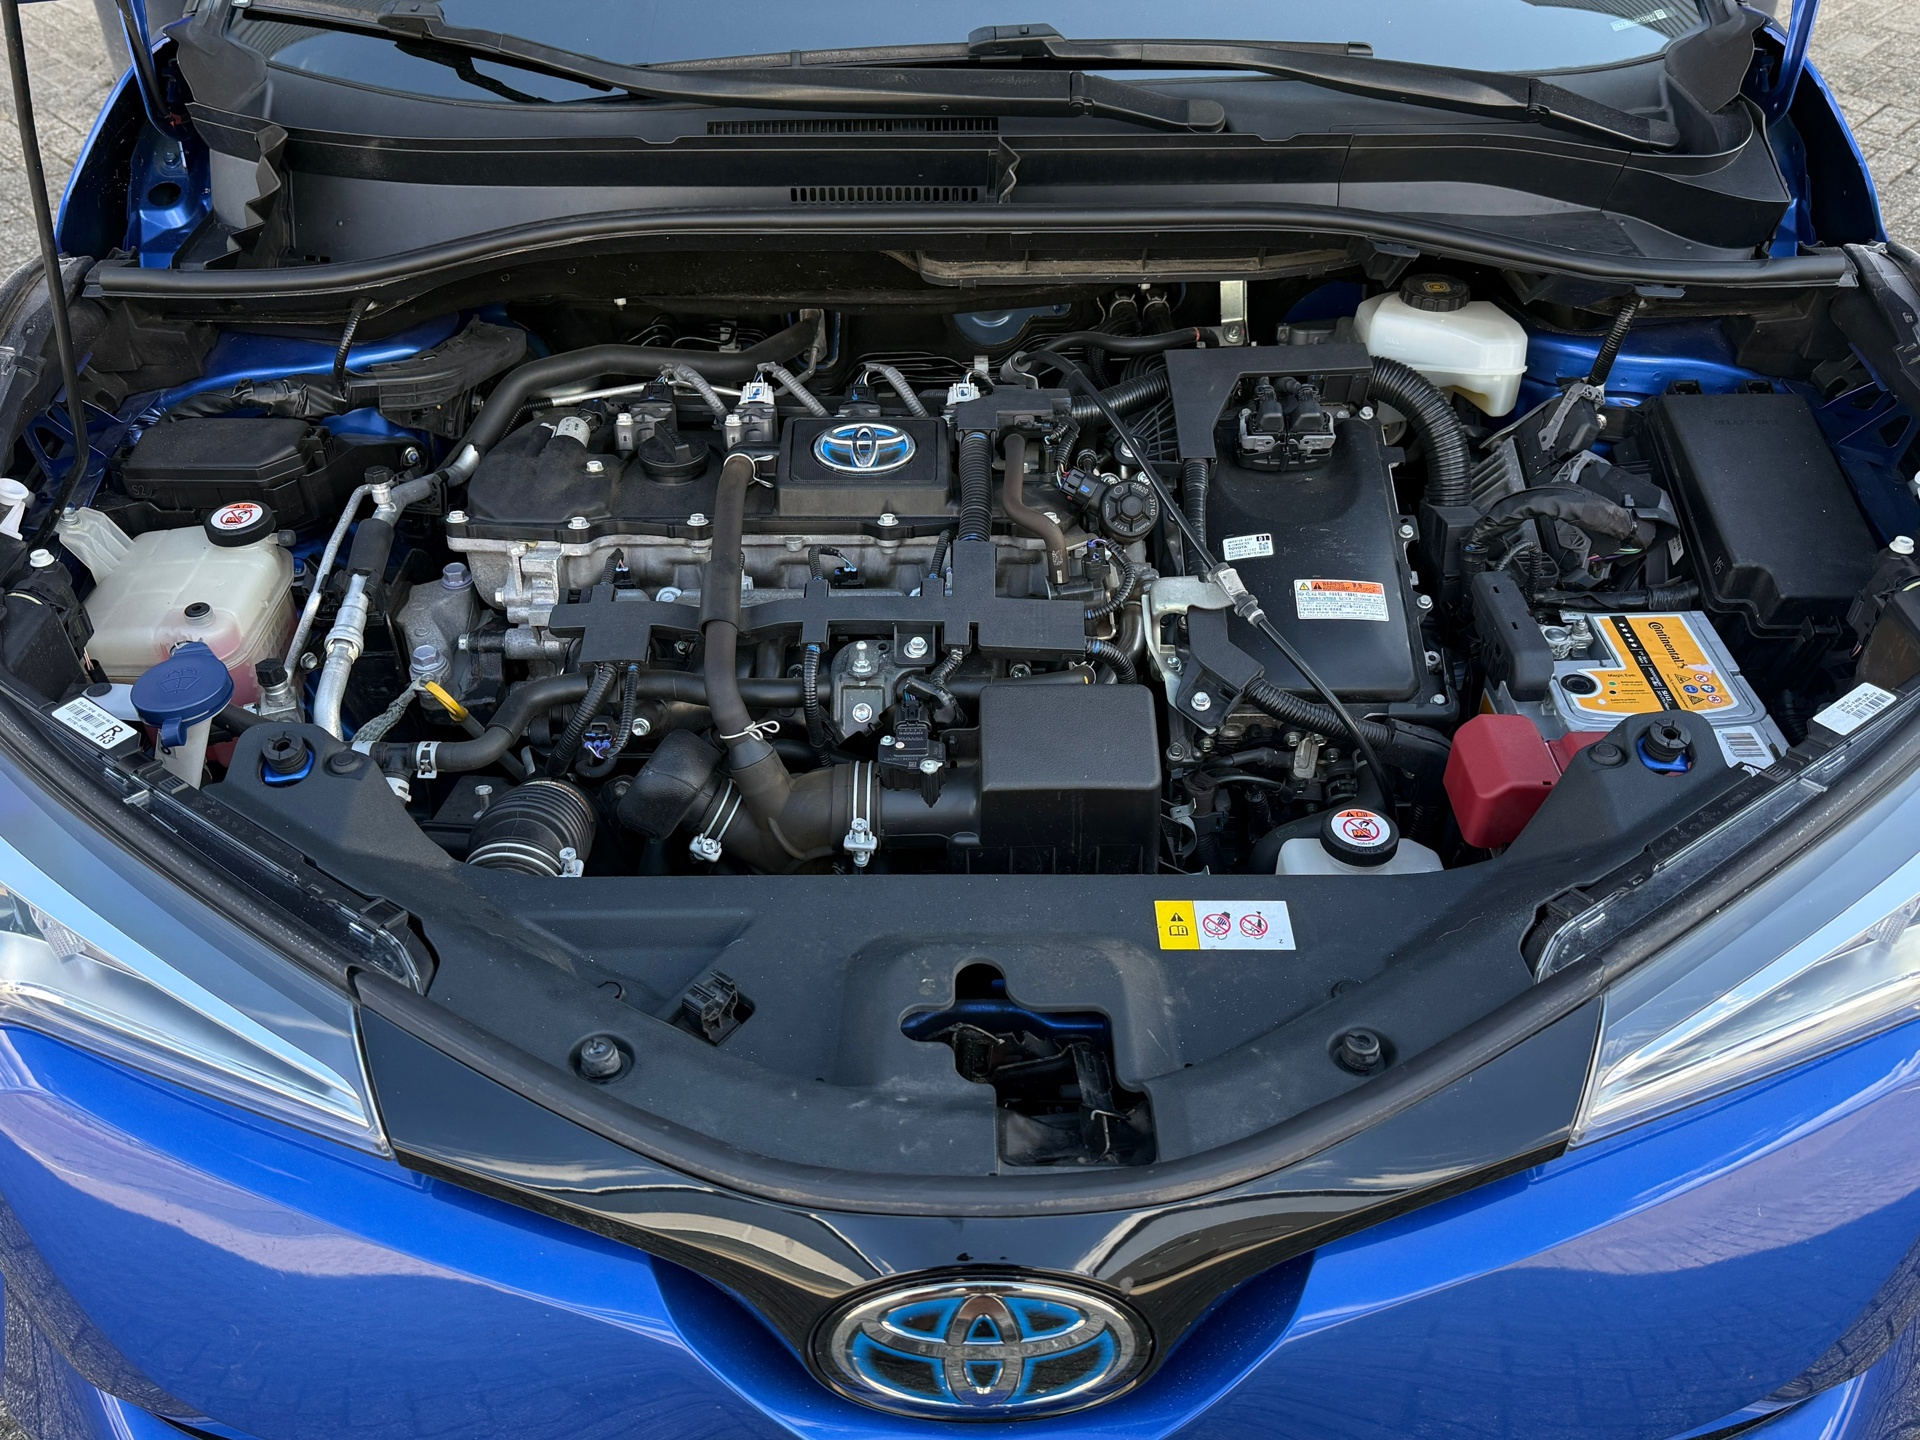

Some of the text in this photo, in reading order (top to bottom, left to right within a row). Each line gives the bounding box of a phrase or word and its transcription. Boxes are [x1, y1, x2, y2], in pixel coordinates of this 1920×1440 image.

[1134, 521, 1151, 533] TOYOTA
[1647, 621, 1683, 668] Continental
[105, 724, 124, 737] R
[95, 732, 116, 745] H3
